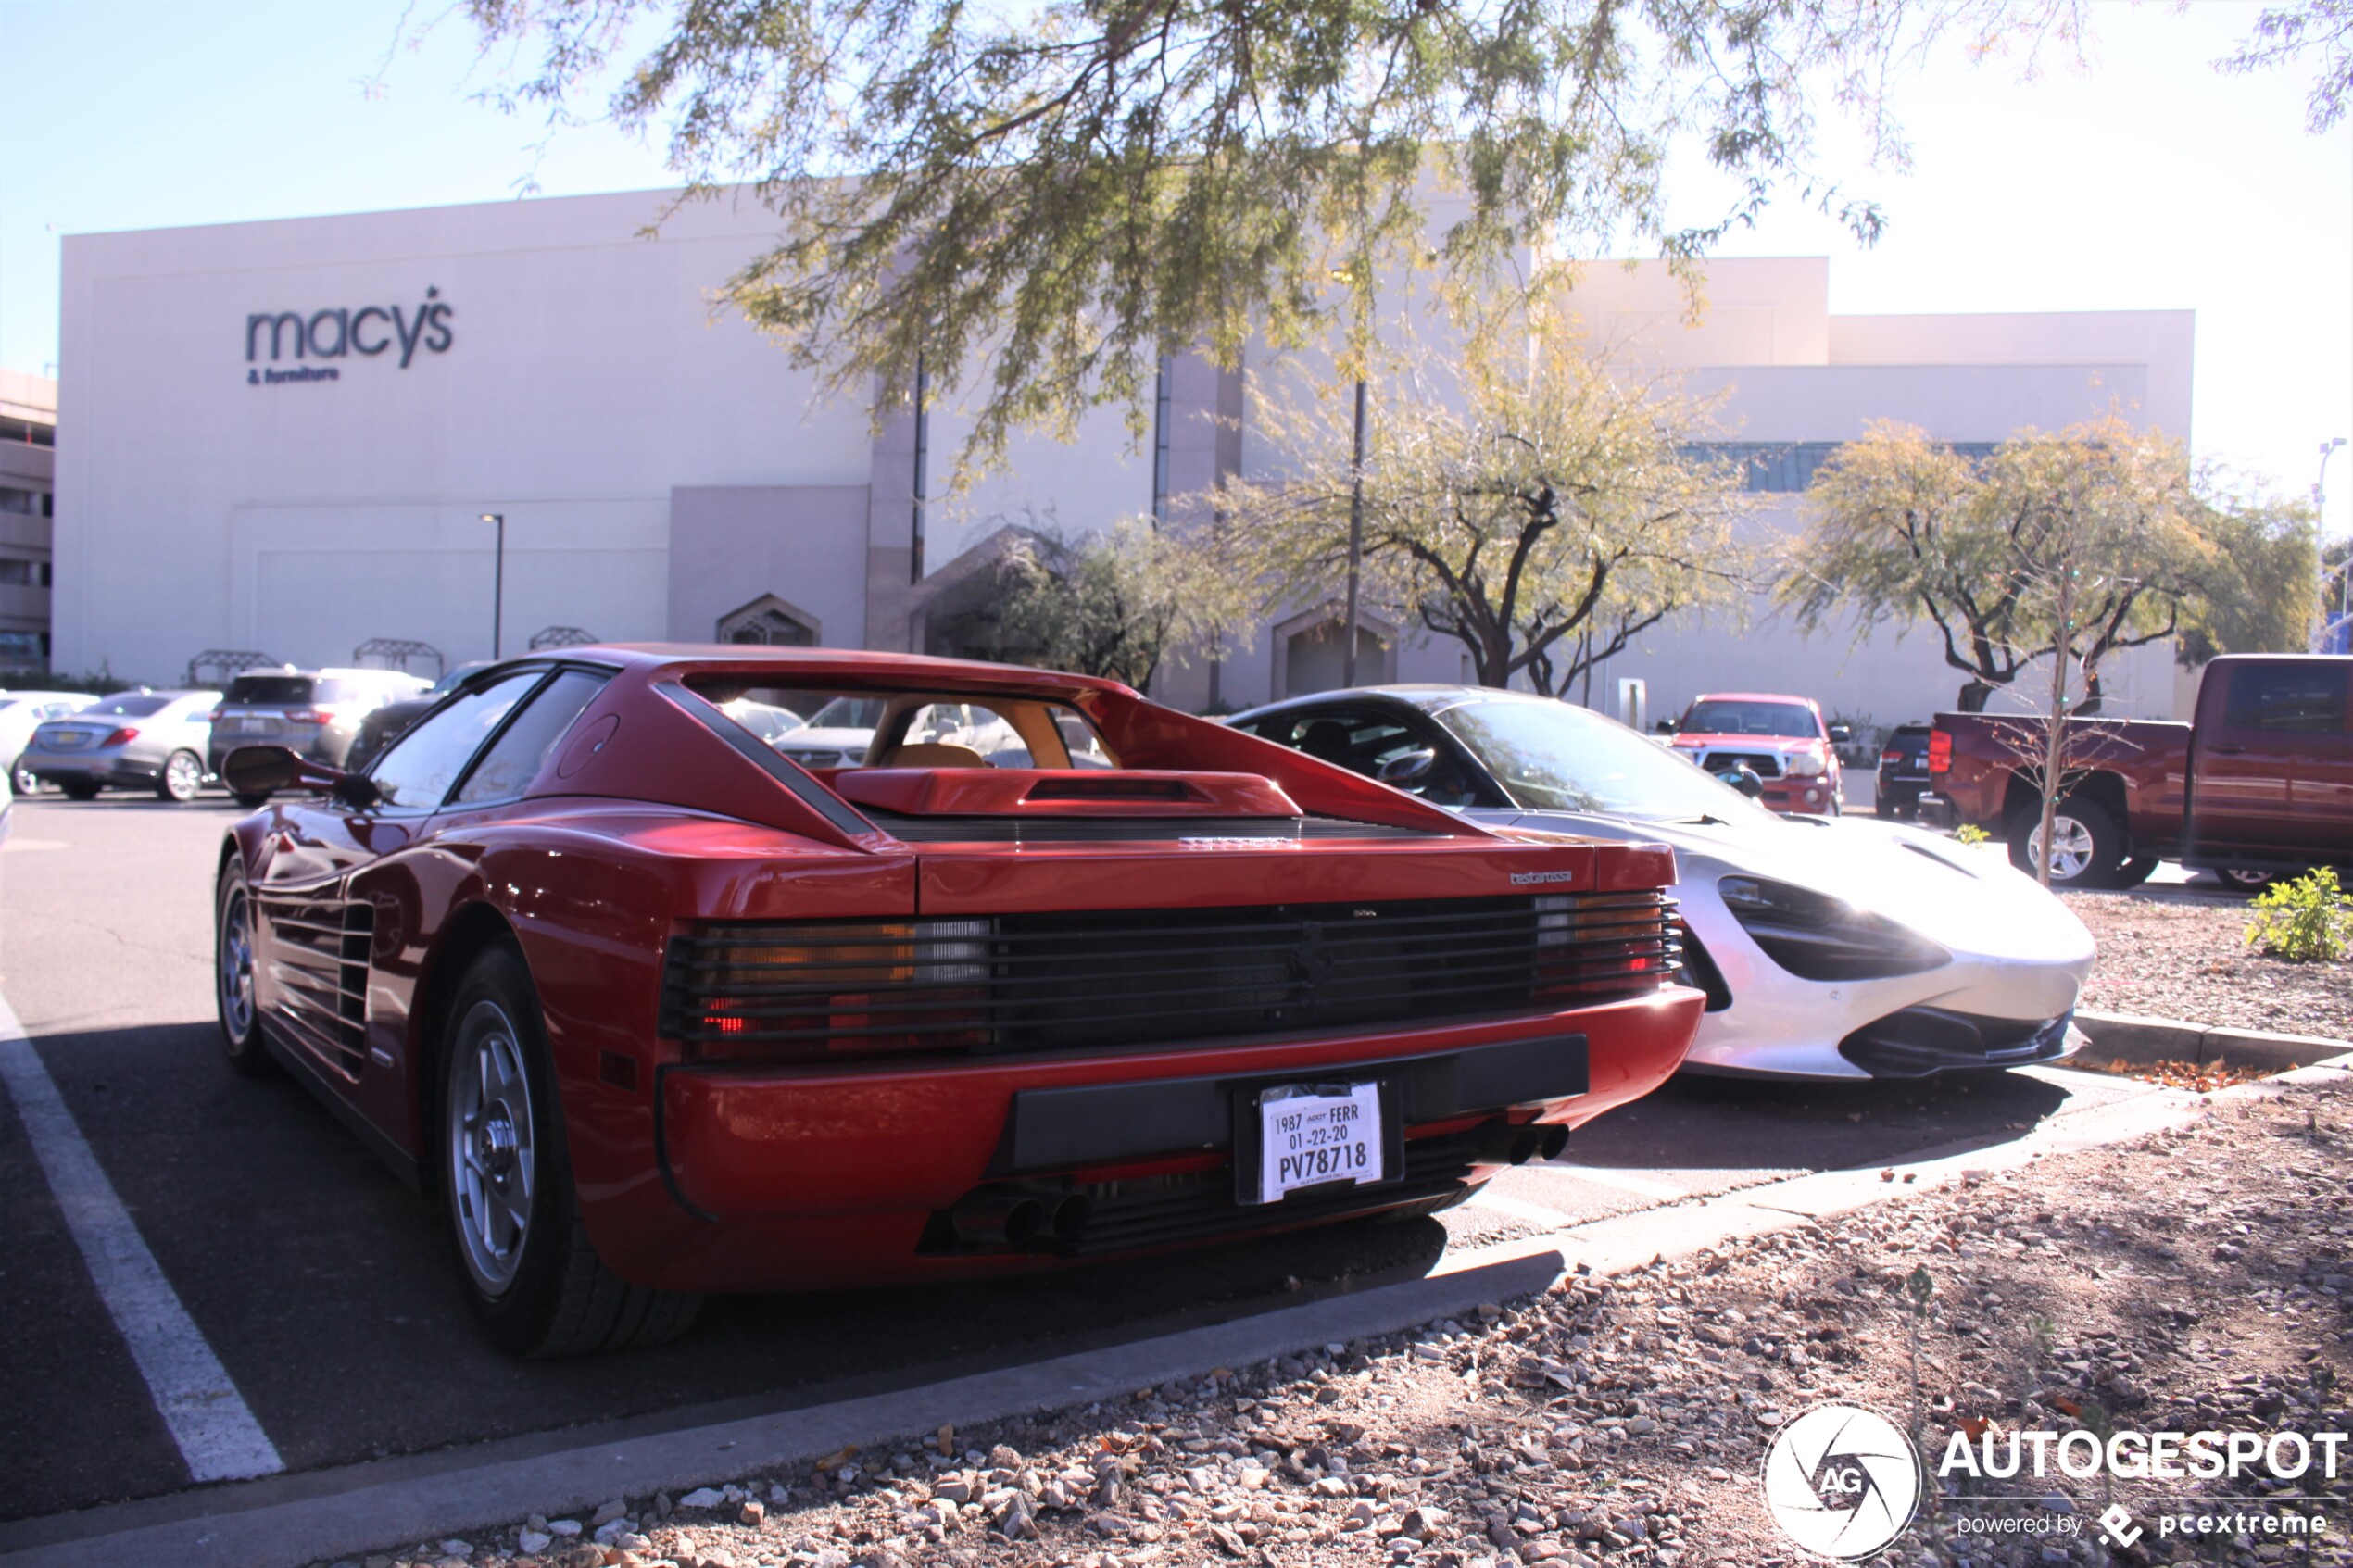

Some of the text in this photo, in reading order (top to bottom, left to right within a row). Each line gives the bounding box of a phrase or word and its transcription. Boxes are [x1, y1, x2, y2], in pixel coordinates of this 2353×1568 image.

[246, 284, 453, 369] macy's
[247, 366, 339, 385] & furniture
[1276, 1113, 1302, 1135] 1987
[1330, 1104, 1359, 1123] FERR
[1279, 1141, 1367, 1184] PV78718
